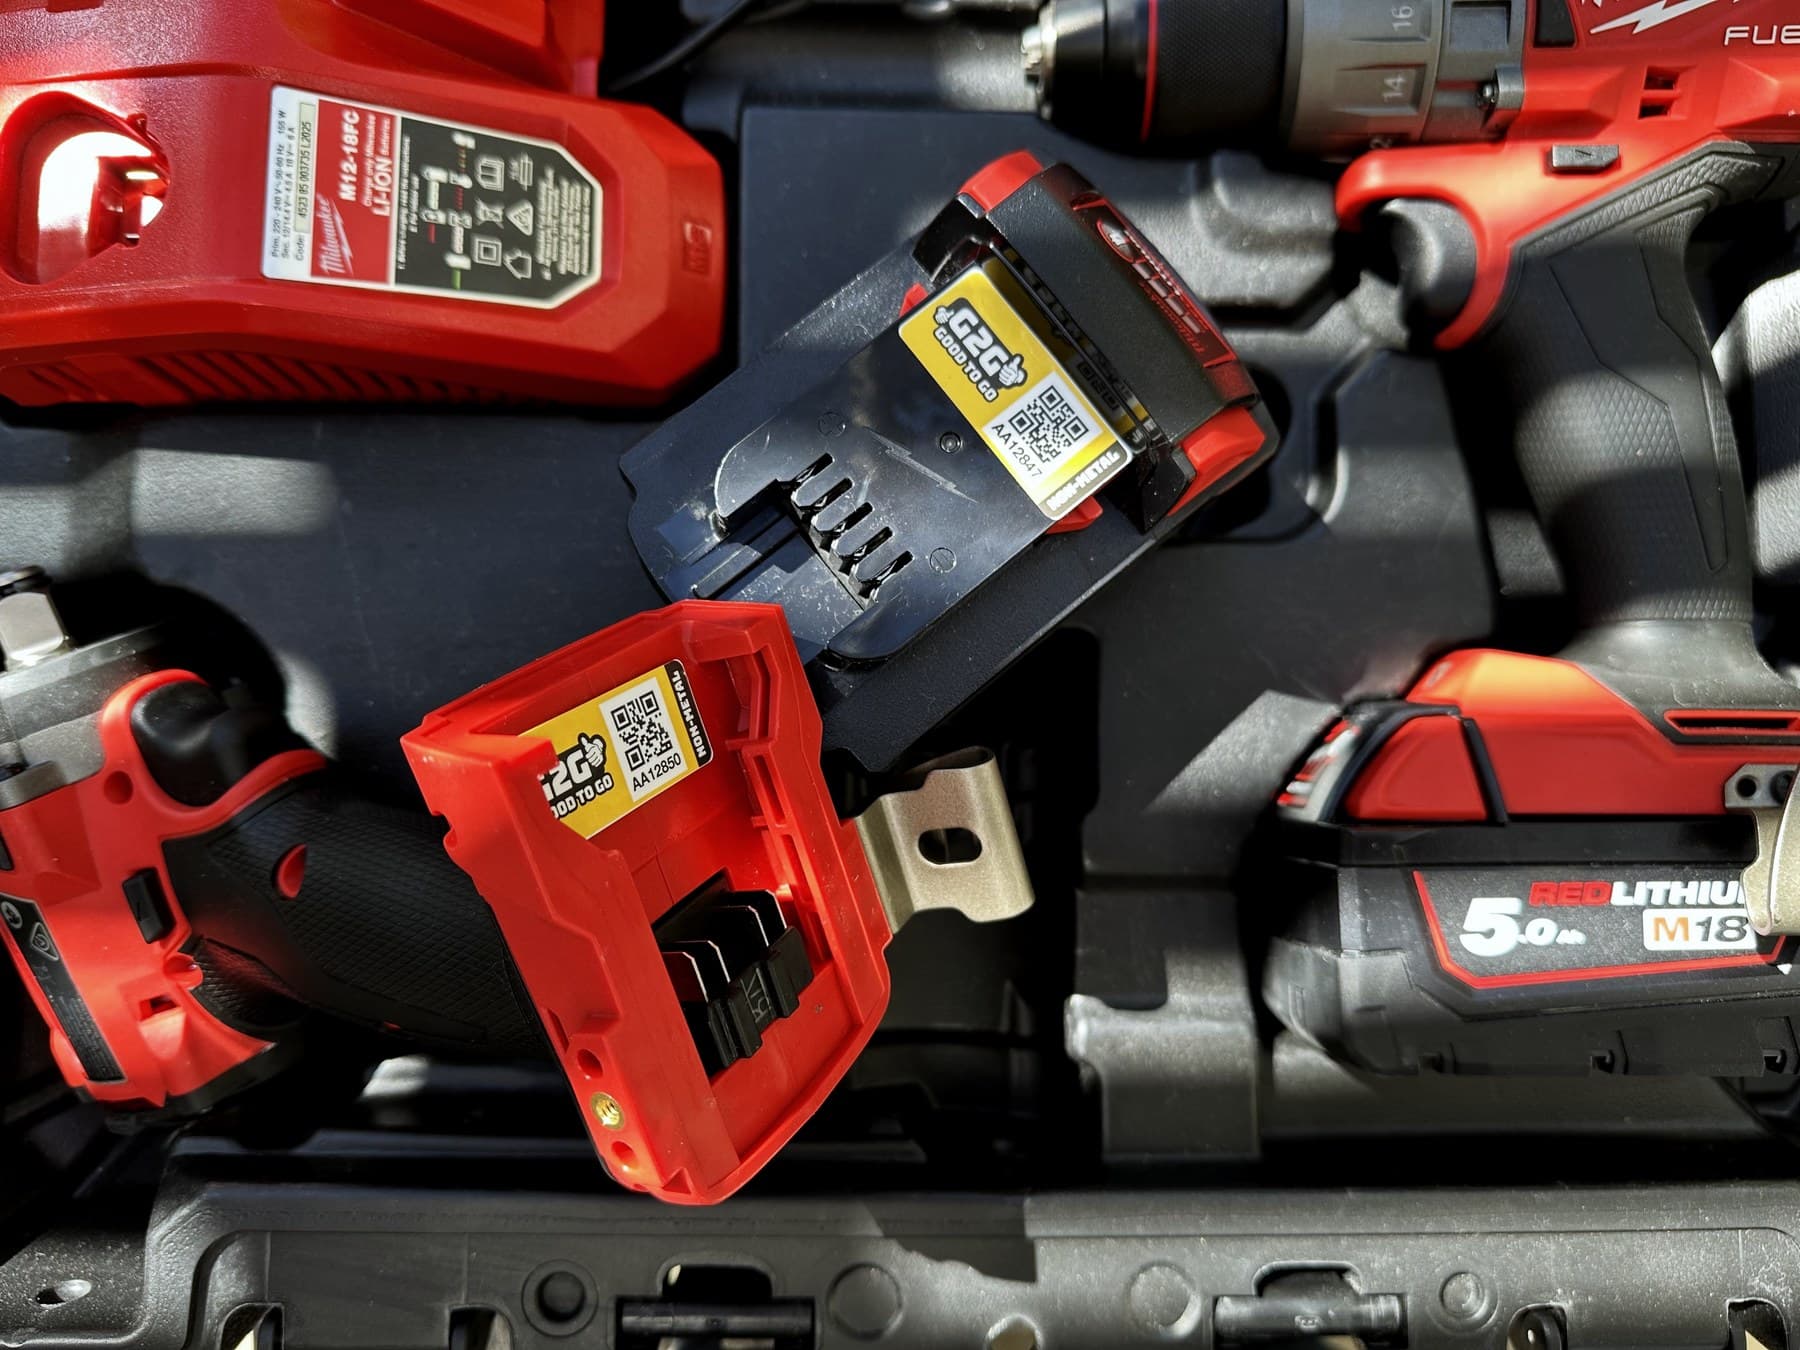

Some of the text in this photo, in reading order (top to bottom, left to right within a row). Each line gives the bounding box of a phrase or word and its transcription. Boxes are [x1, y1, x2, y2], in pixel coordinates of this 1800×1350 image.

[1390, 5, 1413, 32] 16
[1723, 24, 1800, 46] FUE
[1382, 75, 1406, 103] 14
[338, 110, 360, 201] M12-18FC
[297, 197, 309, 219] 4523
[317, 193, 346, 275] Milwaukee
[935, 326, 998, 401] GOOD TO GO
[949, 307, 1009, 377] G2G
[991, 423, 1043, 478] AA12847
[671, 670, 707, 758] NON-METAL
[575, 785, 595, 804] TO
[594, 774, 613, 793] GO
[632, 752, 682, 792] AA12850
